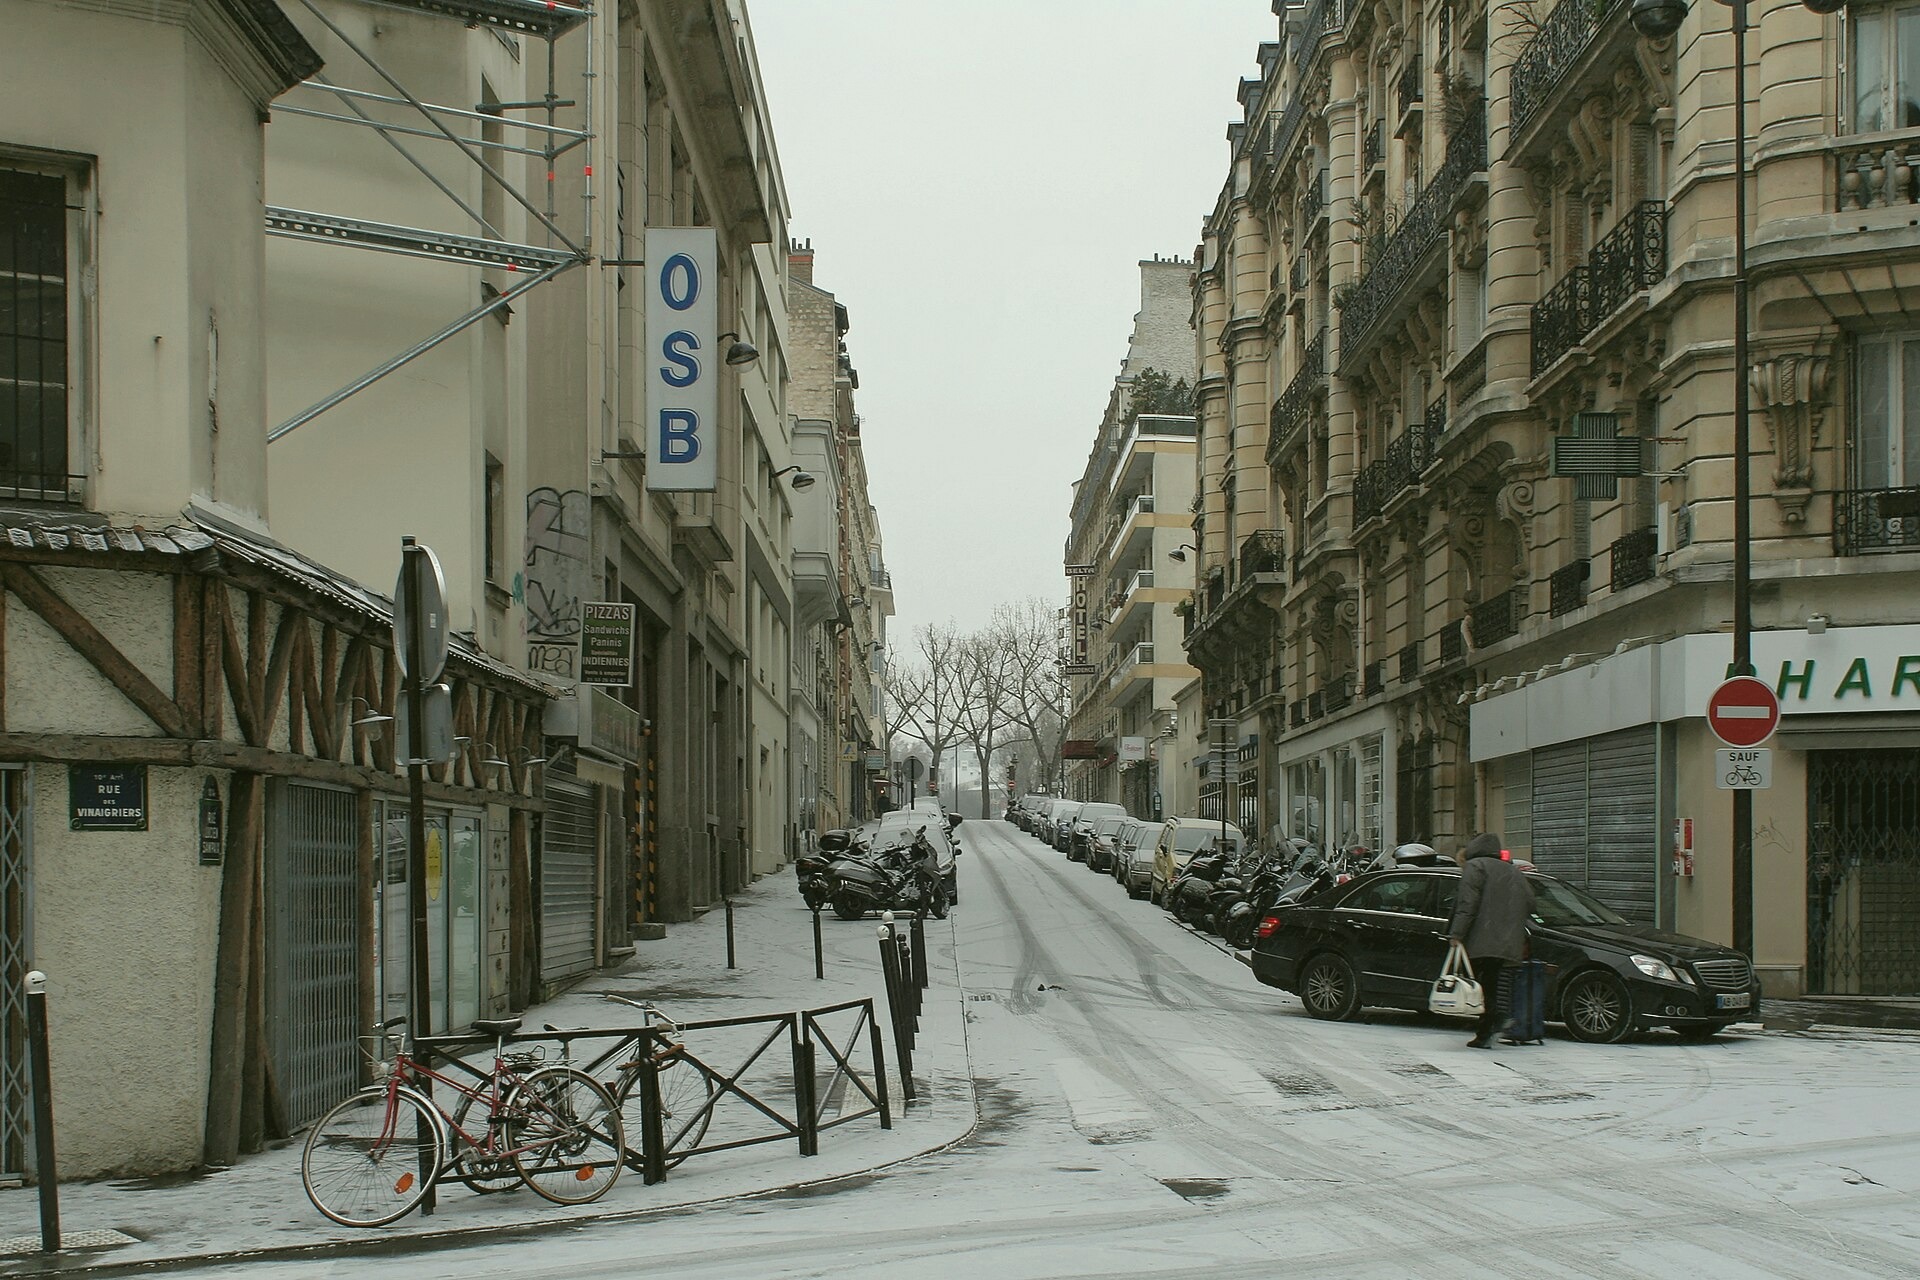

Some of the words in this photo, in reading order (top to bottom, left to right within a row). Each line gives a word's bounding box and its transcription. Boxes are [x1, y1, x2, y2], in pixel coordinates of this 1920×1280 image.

[660, 253, 702, 464] OSB
[585, 606, 629, 620] PIZZAS
[1076, 576, 1087, 657] HOTEL
[584, 624, 630, 635] Sandwichs
[591, 637, 622, 648] Paninis
[582, 656, 630, 667] INDIENNES
[1729, 752, 1760, 762] SAUF
[98, 785, 121, 794] RUE
[77, 807, 142, 817] VINAIGRIERS
